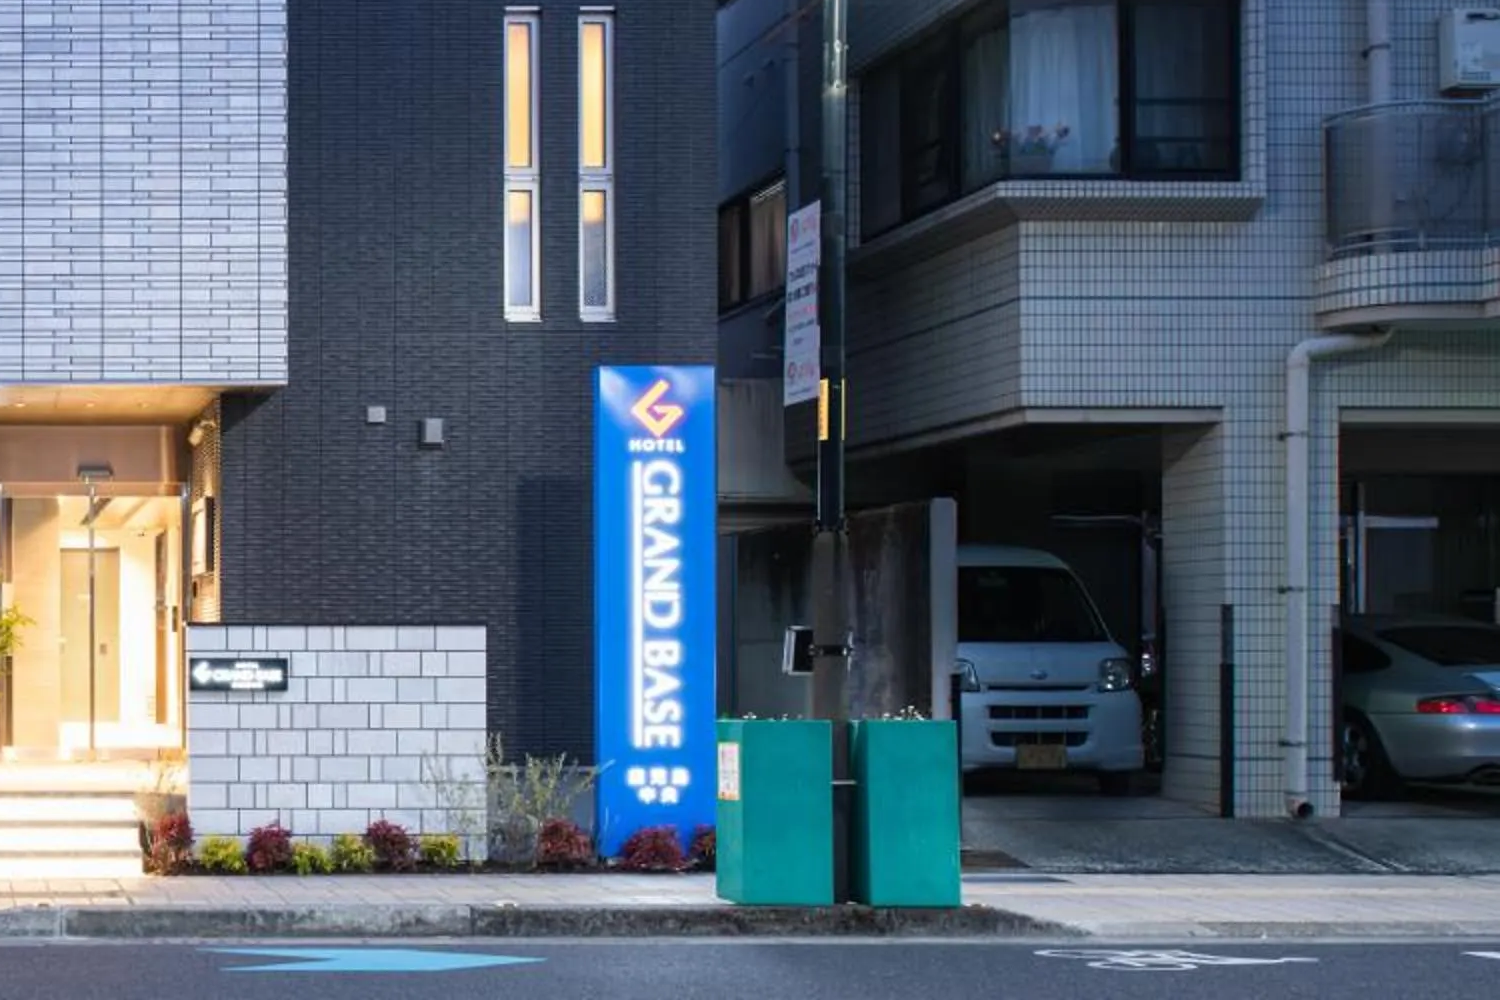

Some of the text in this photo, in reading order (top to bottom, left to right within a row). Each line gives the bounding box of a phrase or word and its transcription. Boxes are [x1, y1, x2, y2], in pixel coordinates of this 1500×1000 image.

[629, 438, 684, 453] HOTEL
[642, 458, 682, 629] GRAND
[642, 639, 682, 748] BASE
